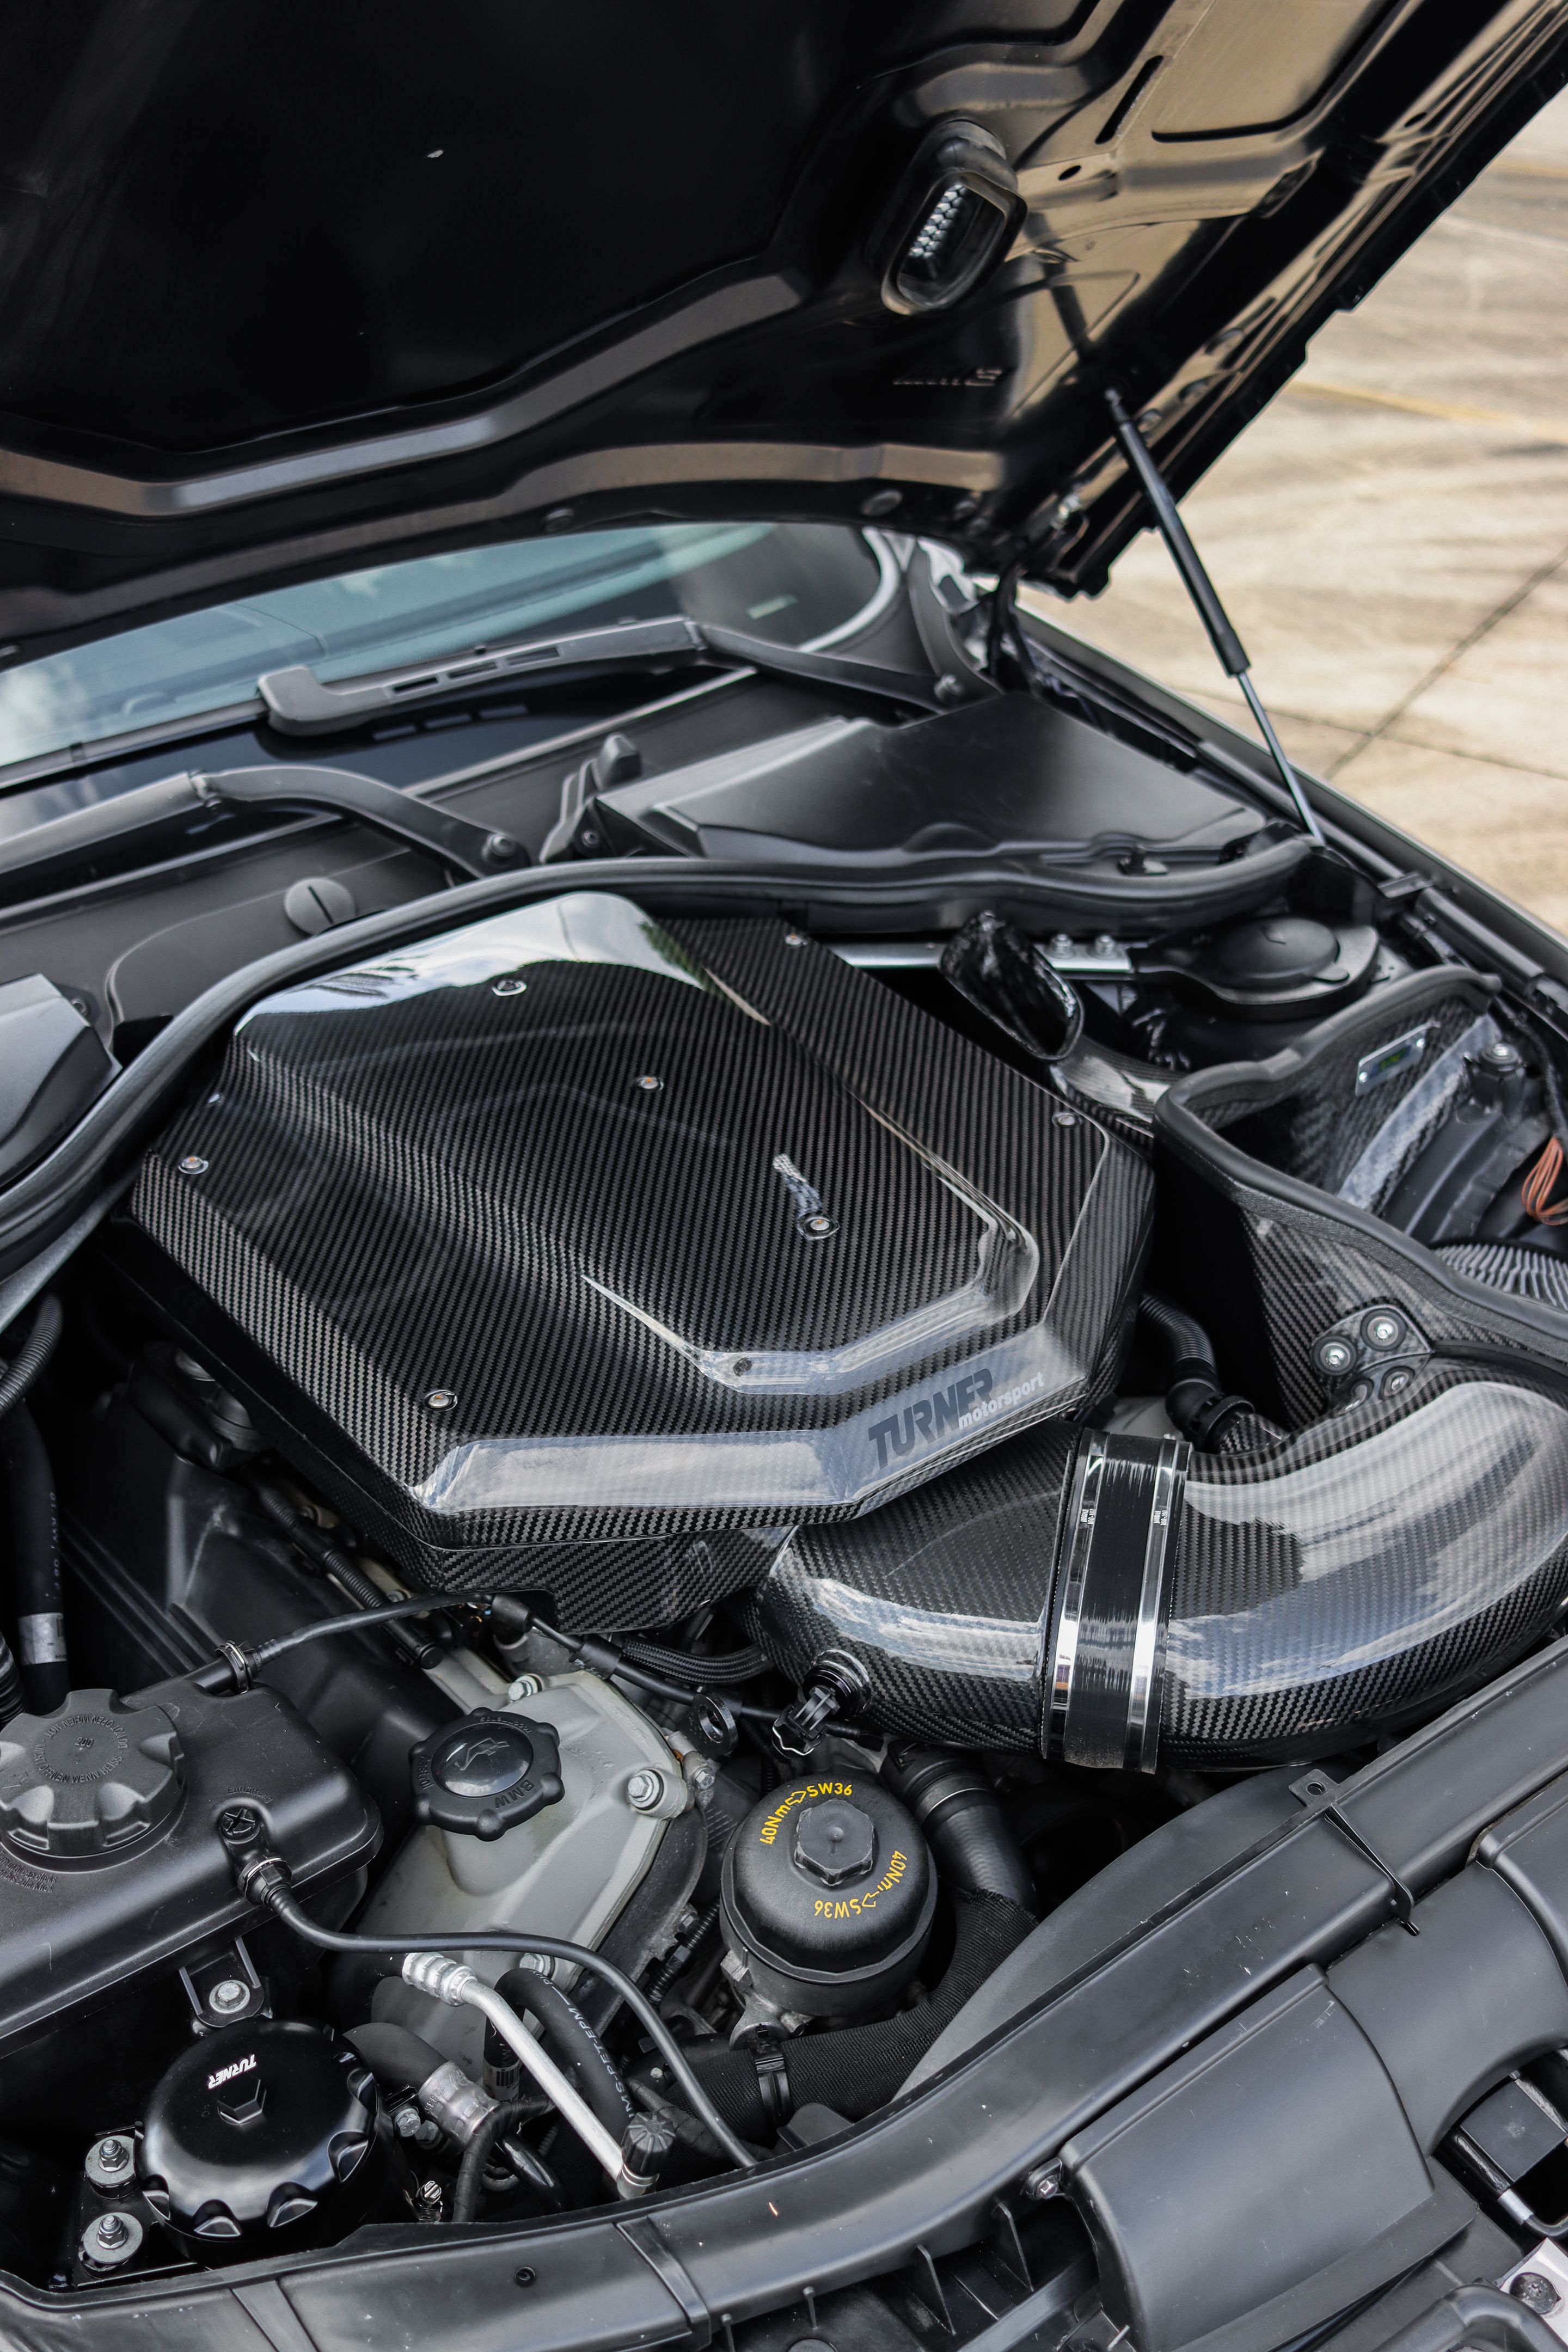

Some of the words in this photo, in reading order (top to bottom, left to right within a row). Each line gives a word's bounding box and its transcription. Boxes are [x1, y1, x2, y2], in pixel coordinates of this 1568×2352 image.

[868, 1369, 993, 1469] TURNER
[958, 1371, 1044, 1430] motorsport
[45, 1724, 62, 1738] HOT
[62, 1716, 89, 1728] WHEN
[91, 1716, 114, 1726] OPEN
[111, 1725, 126, 1738] NOT
[34, 1744, 46, 1764] NICHT
[71, 1771, 100, 1783] WENN
[99, 1755, 123, 1775] HEISS
[418, 1755, 434, 1790] Castrol
[495, 1780, 535, 1809] BMW
[759, 1804, 791, 1845] 40Nm
[806, 1782, 853, 1797] SW36
[877, 1851, 907, 1891] 40Nm
[814, 1899, 862, 1919] SW36
[208, 2054, 256, 2090] TURNER
